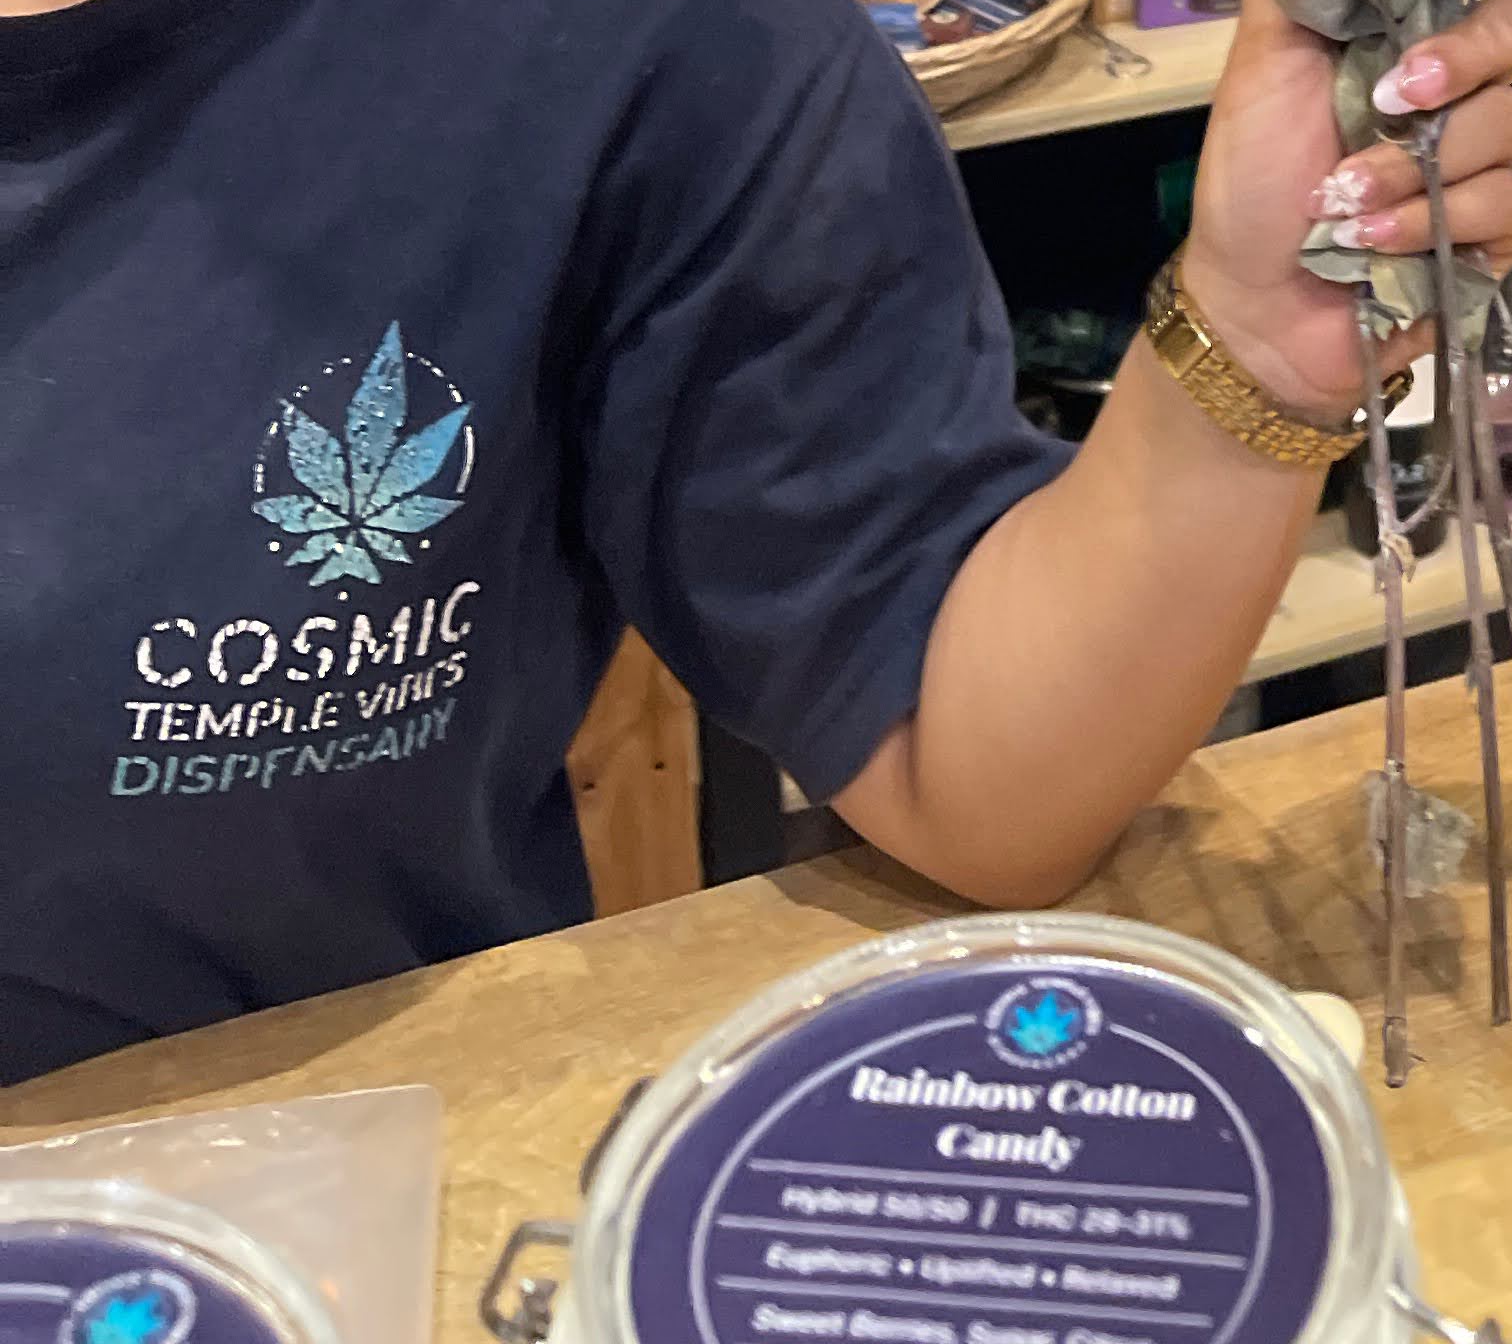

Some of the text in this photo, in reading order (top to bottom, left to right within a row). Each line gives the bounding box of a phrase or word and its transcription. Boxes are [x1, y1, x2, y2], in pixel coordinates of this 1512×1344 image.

[136, 581, 481, 689] COSMIC
[124, 688, 345, 742] TEMPLE
[851, 1066, 1196, 1122] Rainbow Cotton
[934, 1122, 1081, 1172] Candy
